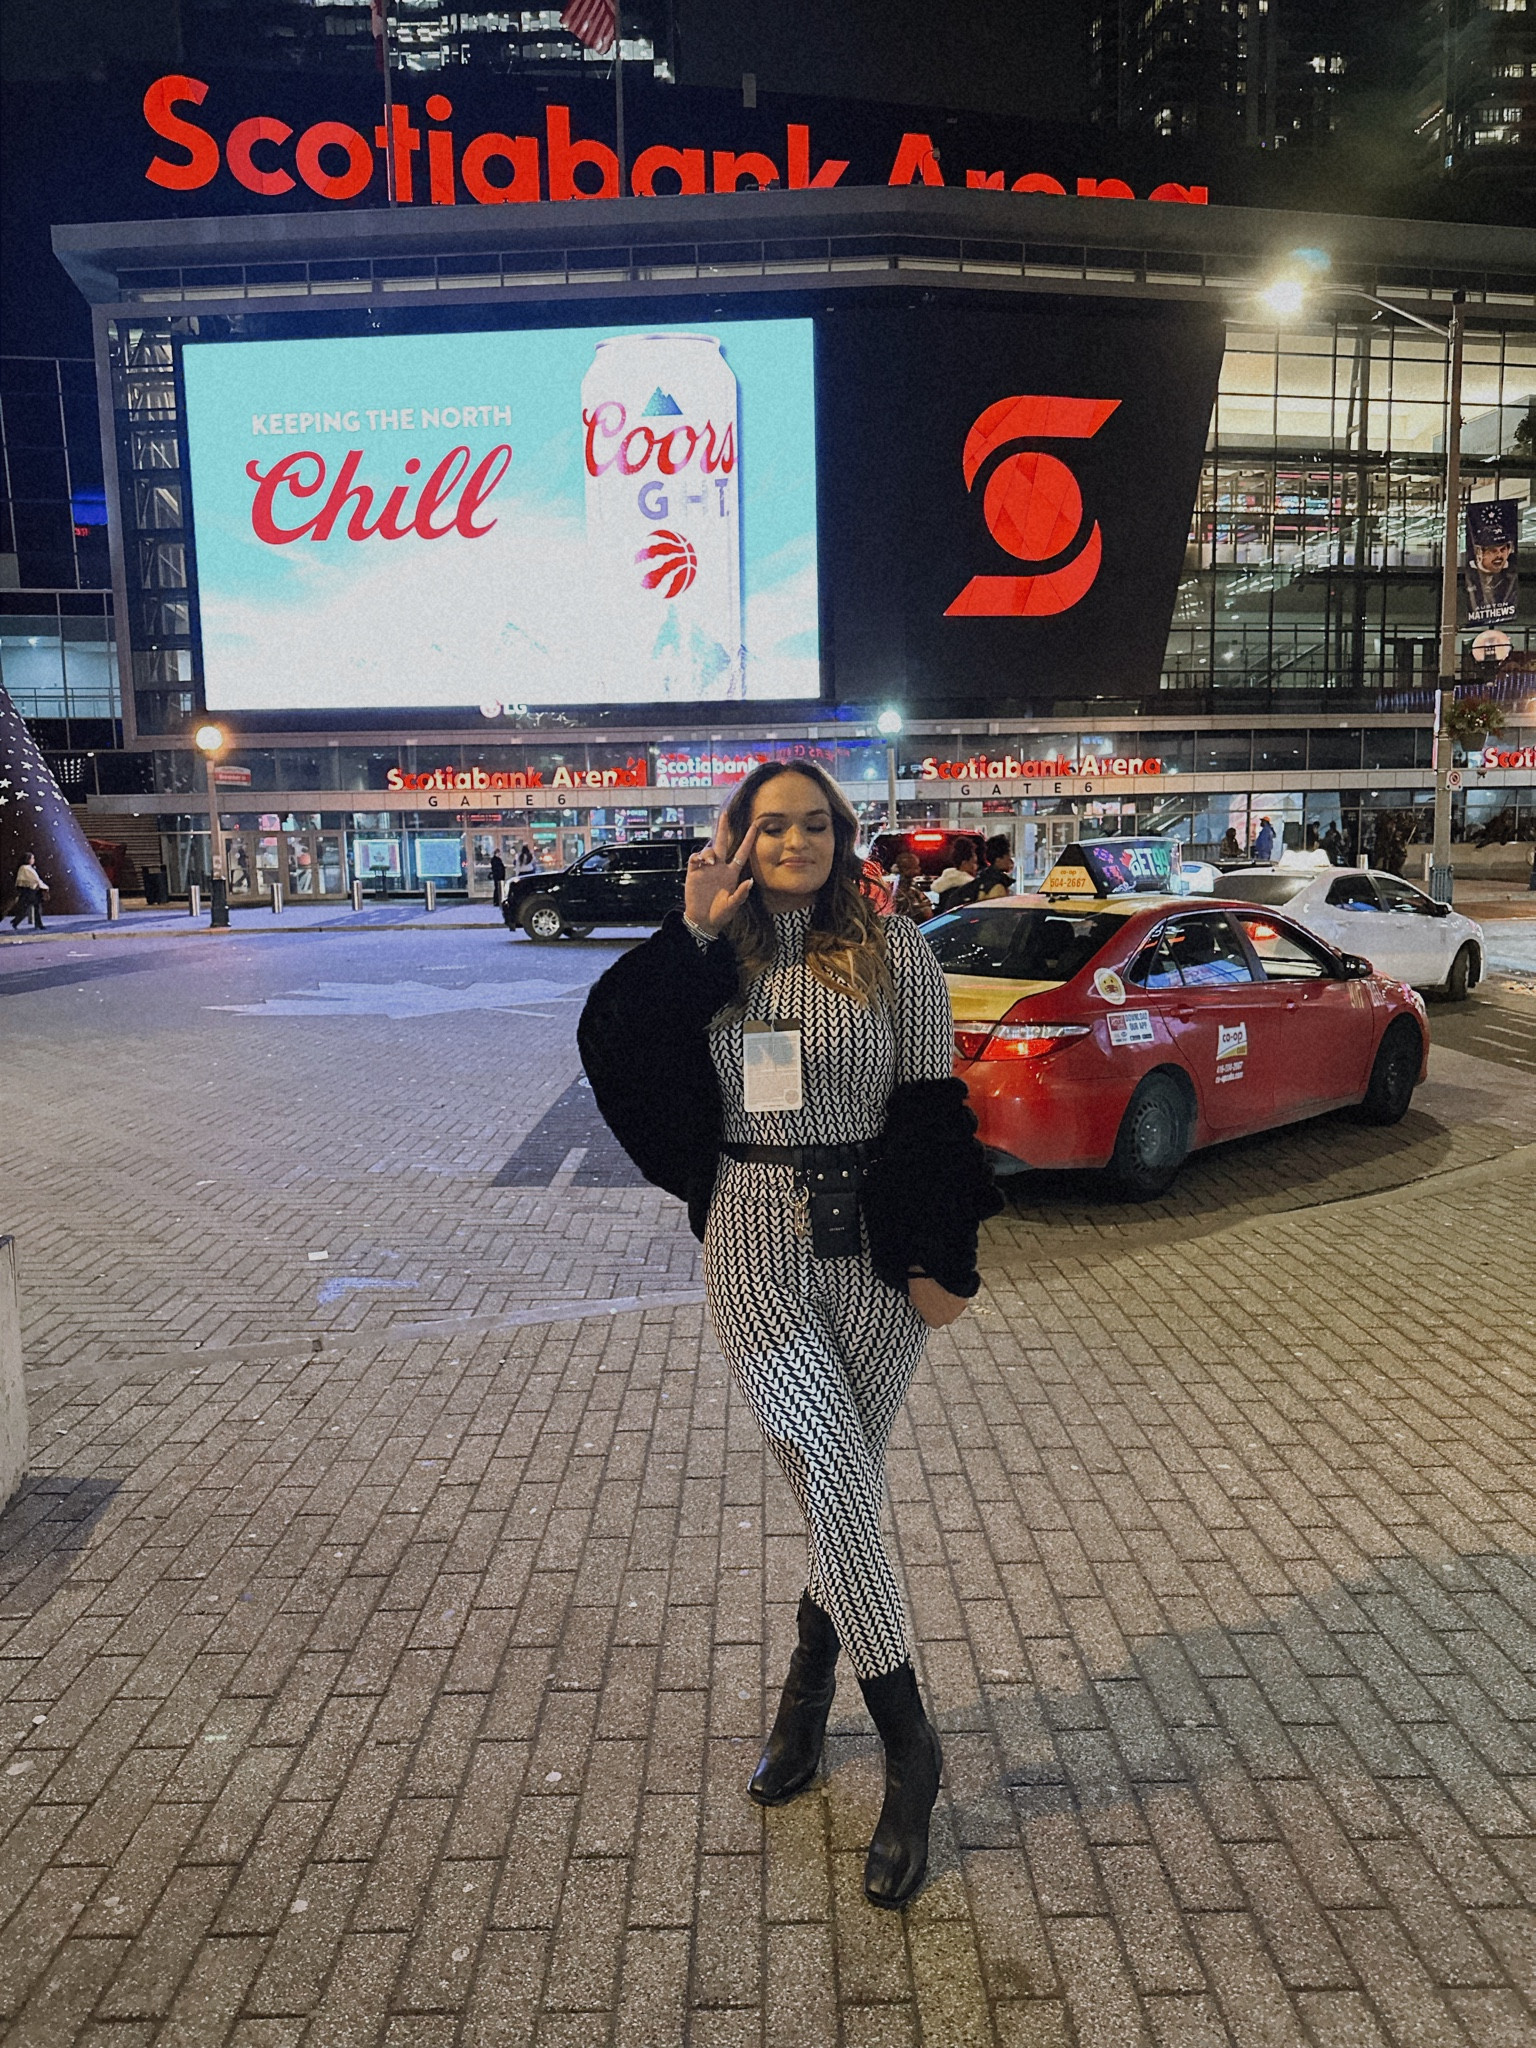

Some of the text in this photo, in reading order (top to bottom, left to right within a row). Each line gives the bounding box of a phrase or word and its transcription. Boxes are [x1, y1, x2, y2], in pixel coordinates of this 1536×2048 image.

[143, 75, 850, 204] Scotiabank
[252, 405, 512, 435] KEEPING THE NORTH
[583, 401, 738, 477] Coors
[246, 444, 512, 545] Chill
[1468, 605, 1515, 621] MATTHEWS
[923, 754, 1162, 780] Scotiabank Arena
[1485, 746, 1536, 769] Scot
[387, 765, 638, 790] Scotiabank Arena
[656, 774, 712, 788] Arena
[961, 782, 1093, 796] GATE 6
[428, 794, 566, 807] GATE 6
[1222, 1031, 1243, 1044] co-op
